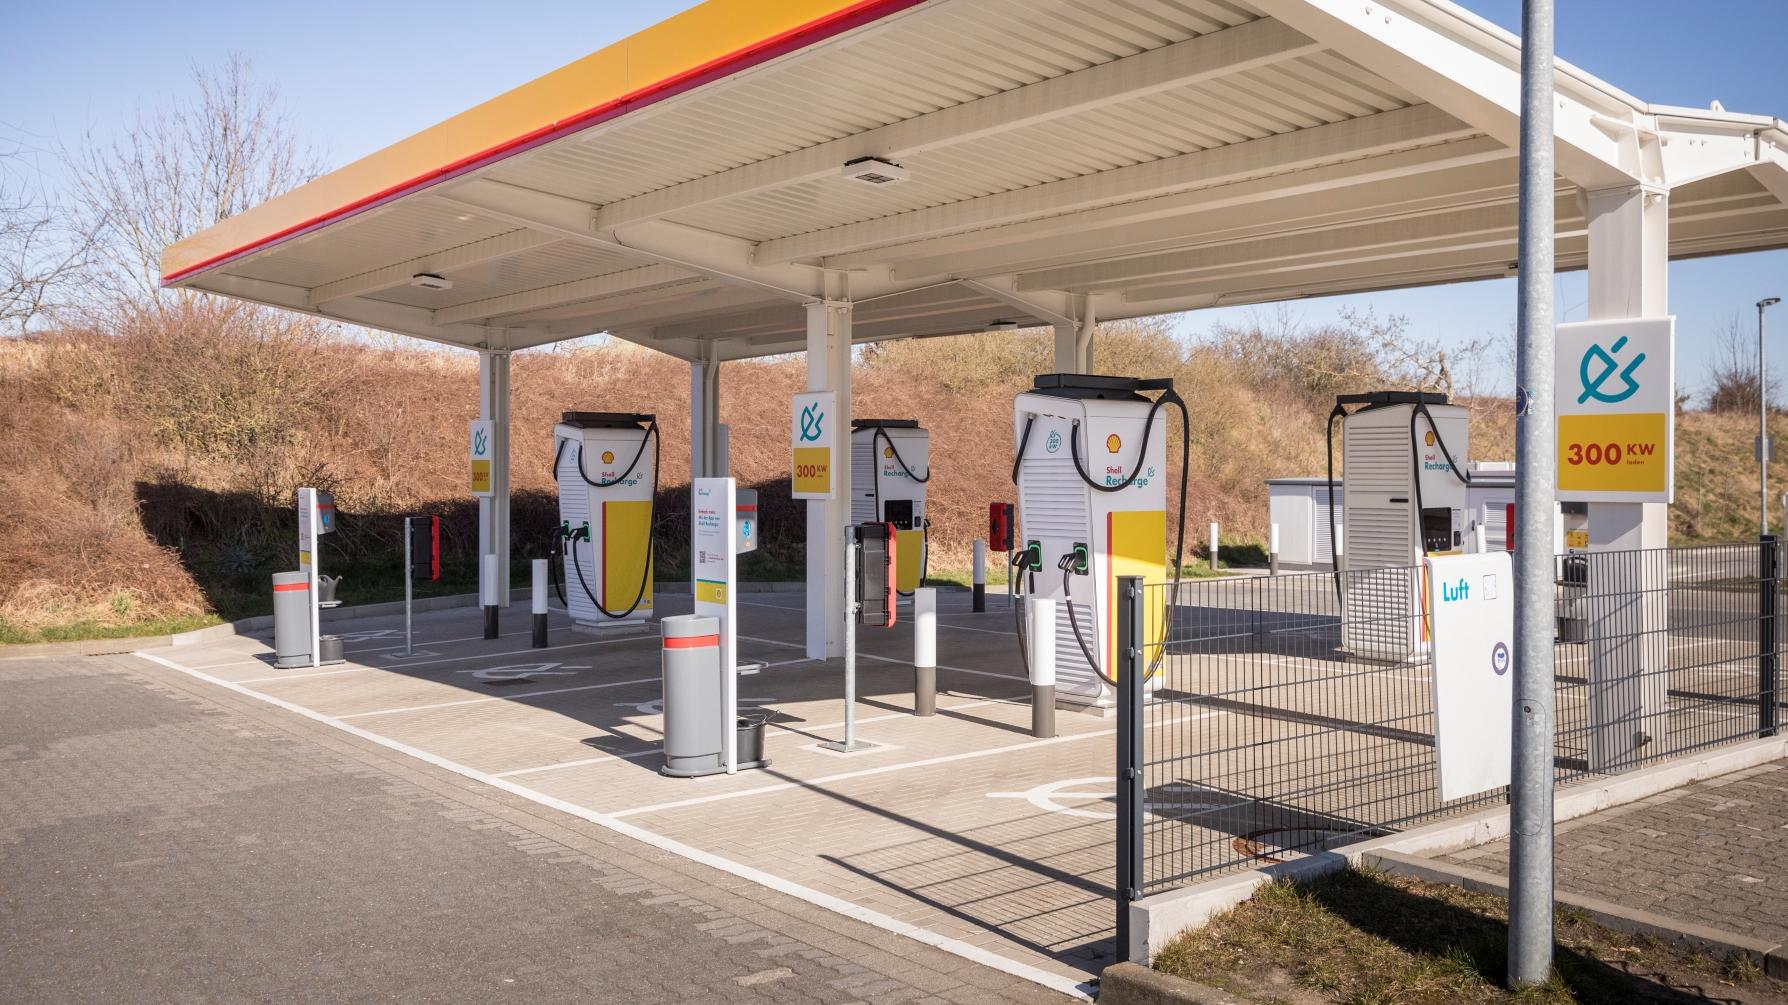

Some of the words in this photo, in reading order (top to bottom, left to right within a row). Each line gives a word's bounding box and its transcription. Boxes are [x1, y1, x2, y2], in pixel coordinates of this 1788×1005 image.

[1567, 443, 1622, 466] 300
[1626, 443, 1655, 456] KW
[797, 464, 816, 478] 300
[1106, 466, 1122, 474] Shell
[1424, 461, 1454, 473] Recharg
[884, 470, 911, 478] Recharg
[1443, 578, 1470, 602] Luft
